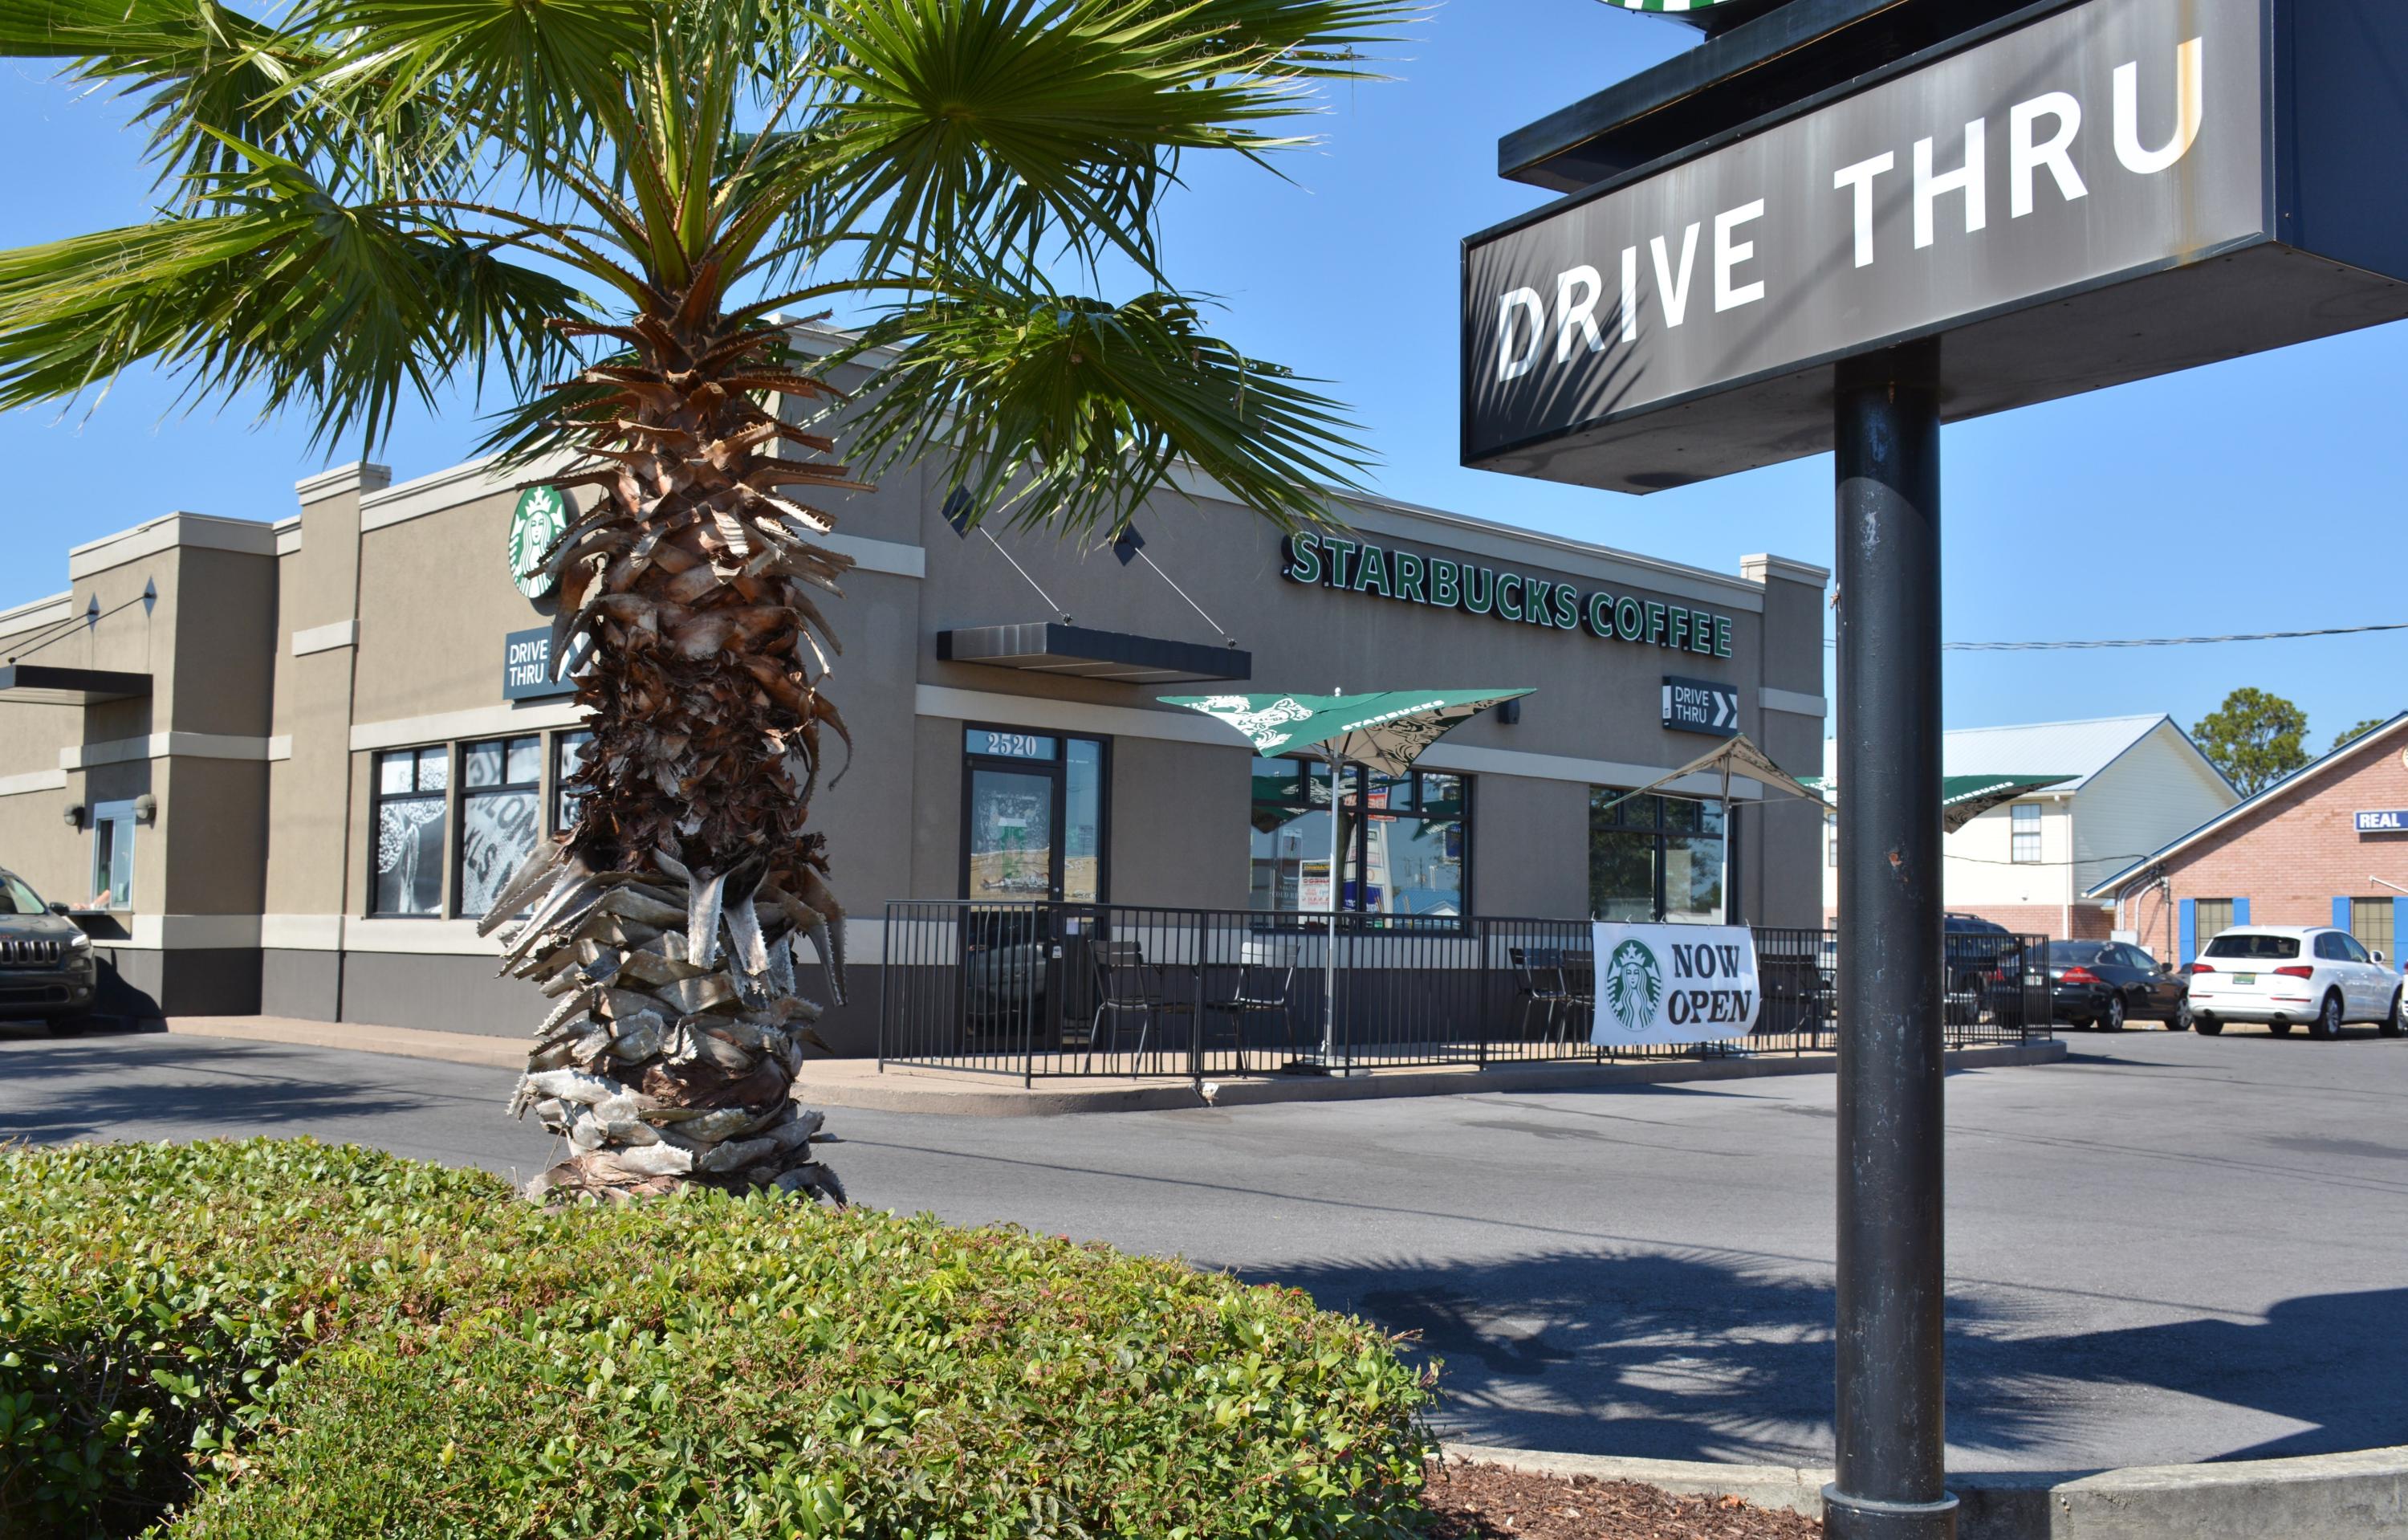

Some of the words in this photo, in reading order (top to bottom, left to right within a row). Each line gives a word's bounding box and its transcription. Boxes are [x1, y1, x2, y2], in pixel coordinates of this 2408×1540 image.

[1498, 197, 1765, 384] DRIVE
[1833, 36, 2205, 269] THRU
[1290, 530, 1579, 630] STARBUCKS
[1588, 592, 1732, 658] COFFEE
[509, 638, 548, 665] DRIVE
[509, 663, 544, 687] THRU
[1674, 686, 1710, 707] DRIVE
[1341, 699, 1445, 731] STARBUCKS
[1675, 703, 1707, 724] THRU
[987, 732, 1037, 756] 2520
[1942, 780, 2015, 805] STARBUCKS
[2359, 812, 2402, 829] REAL
[1671, 943, 1740, 979] NOW
[1668, 989, 1752, 1025] OPEN
